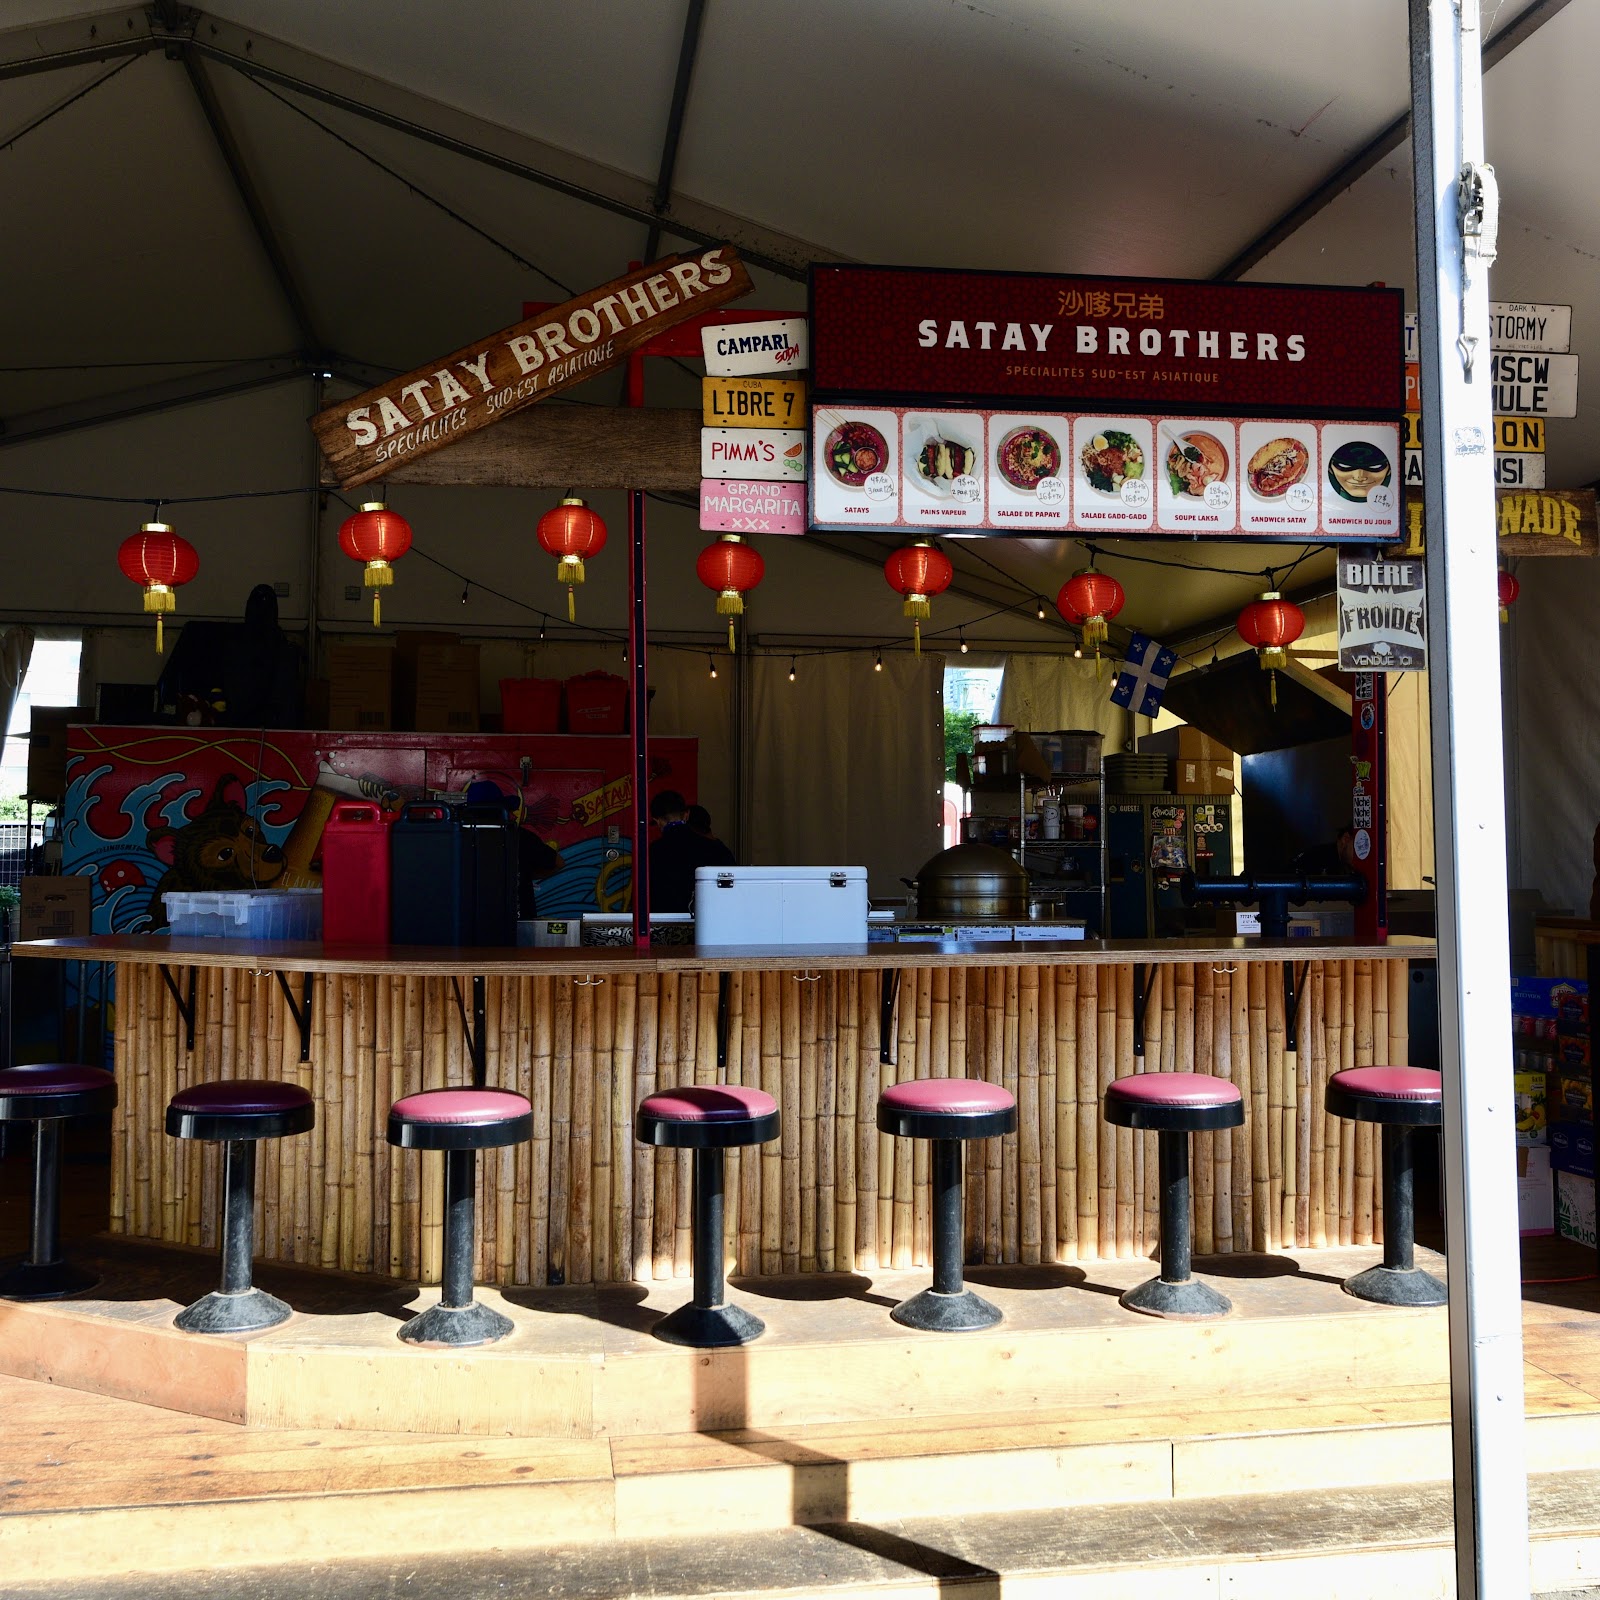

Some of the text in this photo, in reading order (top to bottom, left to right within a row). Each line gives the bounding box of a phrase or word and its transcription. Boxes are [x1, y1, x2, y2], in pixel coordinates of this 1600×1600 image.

[1058, 290, 1164, 319] 沙嗲兄弟
[1509, 304, 1527, 312] DARK
[346, 249, 736, 447] SATAY BROTHERS
[717, 334, 789, 356] CAMPARI
[918, 319, 1306, 362] SATAY BROTHERS
[775, 343, 800, 364] SODA
[742, 381, 762, 389] CUBA
[1091, 368, 1148, 381] SUD-EST
[1153, 371, 1219, 383] ASIATIQUE
[486, 376, 539, 415] SUD-EST
[713, 390, 795, 416] LIBRE 9
[1492, 385, 1548, 412] ULE
[711, 440, 775, 461] PIMM'S
[727, 484, 780, 496] GRAND
[704, 496, 801, 515] MARGARITA
[1198, 514, 1219, 522] LAKSA
[1374, 518, 1392, 526] JOUR
[1346, 561, 1413, 586] BIÈRE
[1342, 602, 1422, 635] FROIDE
[1352, 655, 1394, 666] VENDUE
